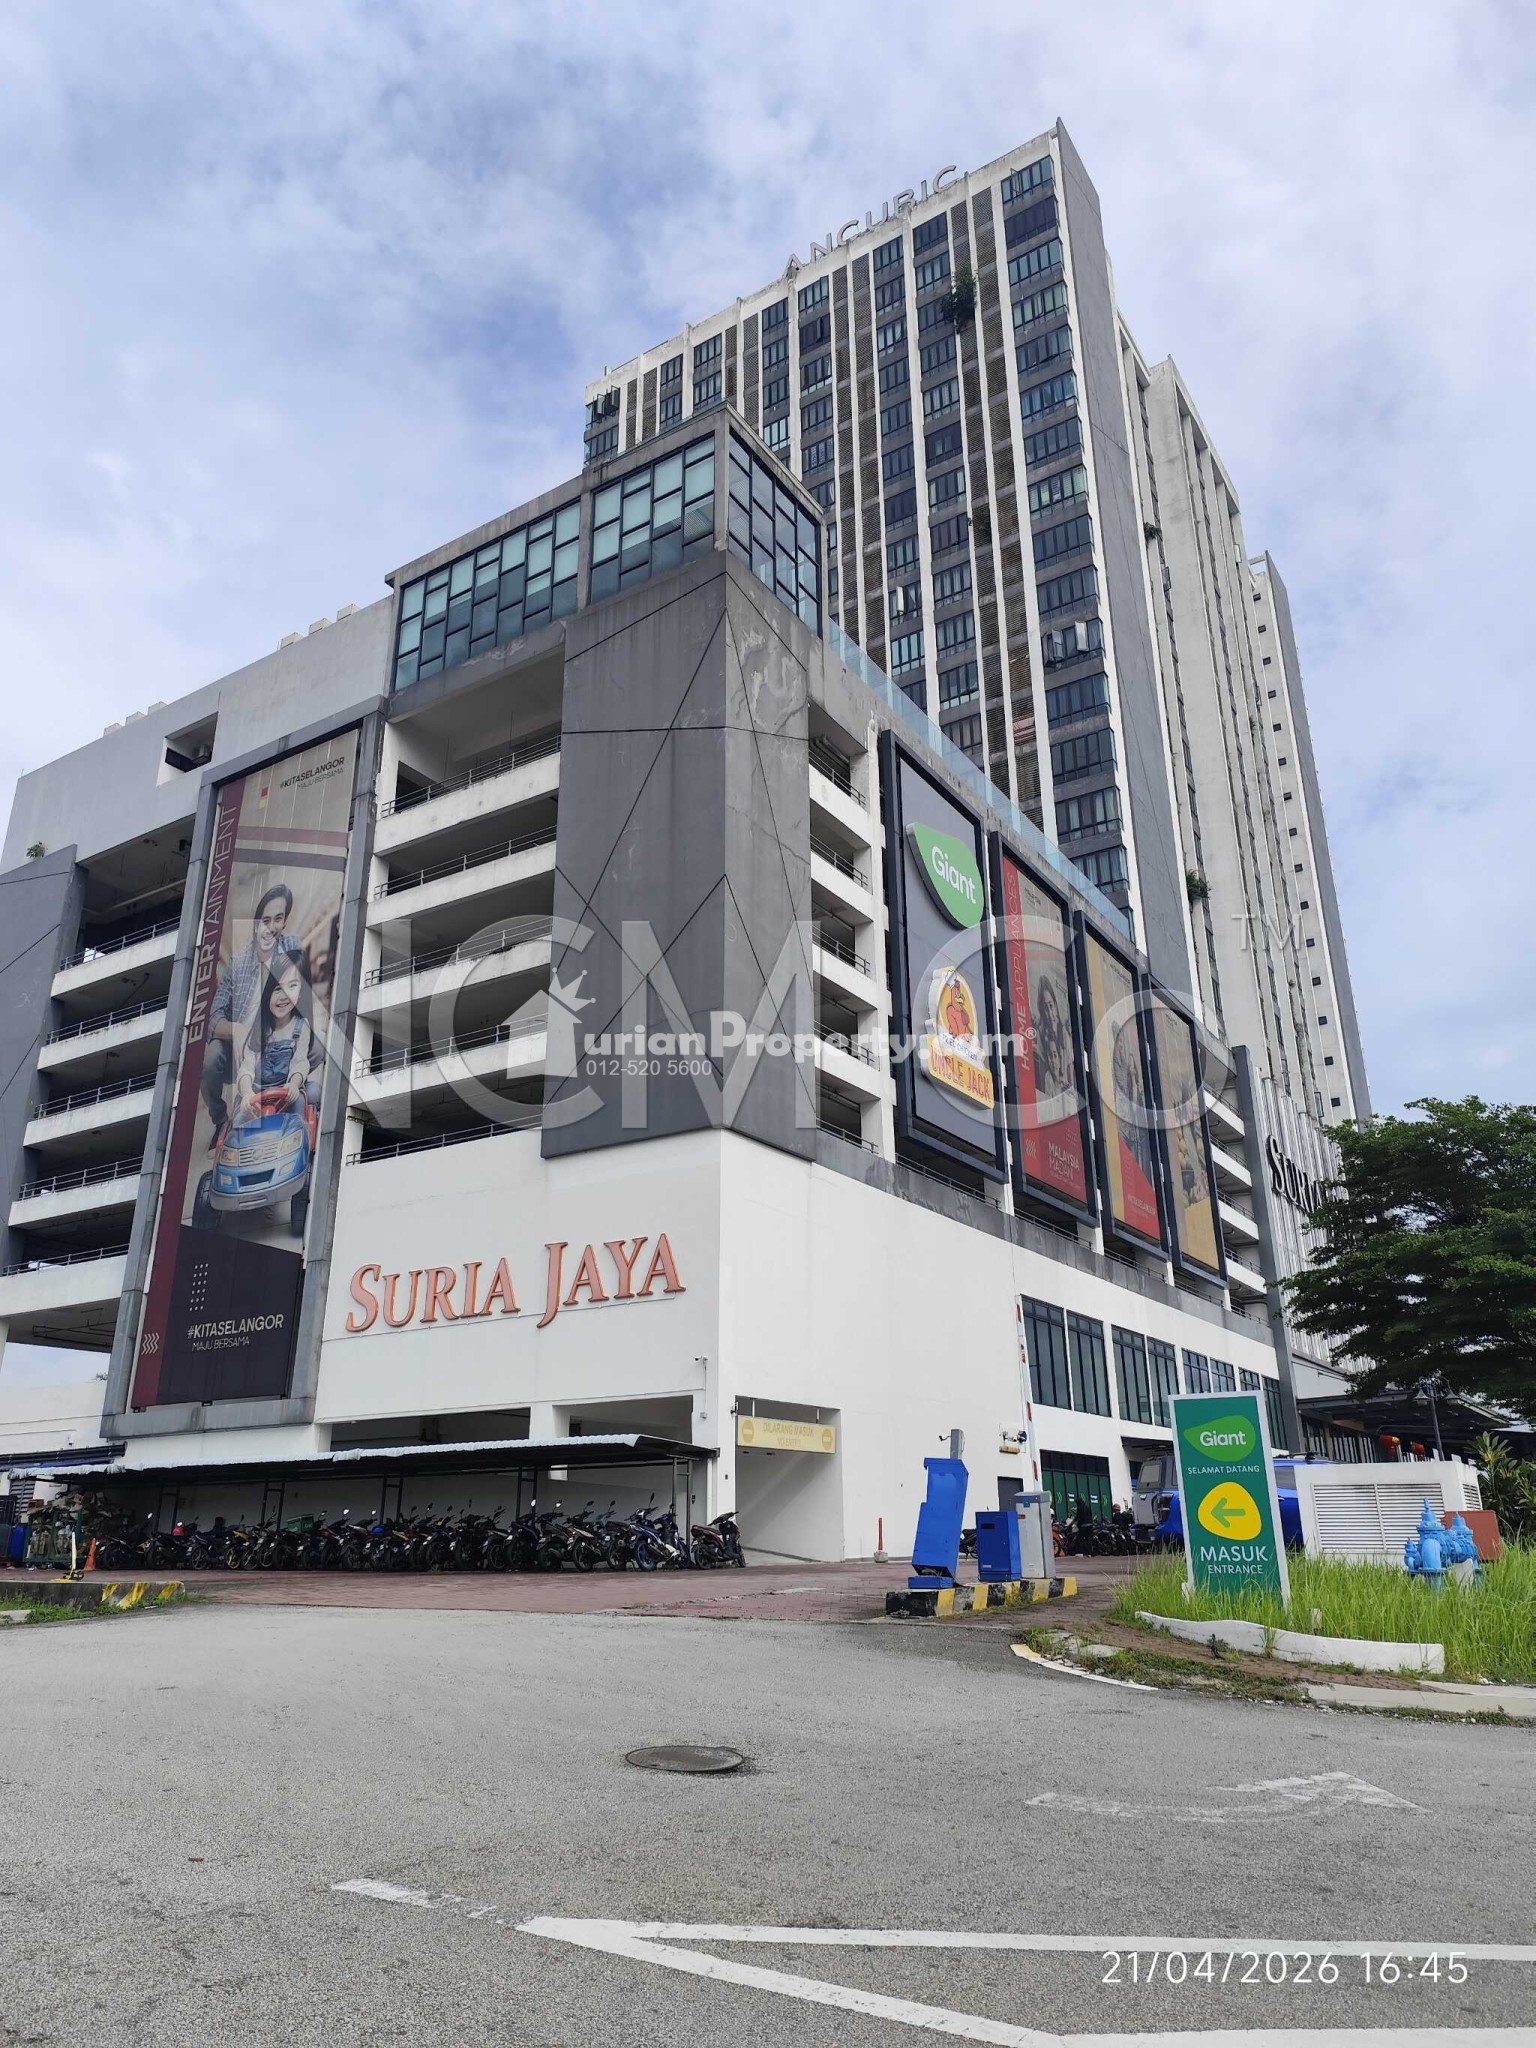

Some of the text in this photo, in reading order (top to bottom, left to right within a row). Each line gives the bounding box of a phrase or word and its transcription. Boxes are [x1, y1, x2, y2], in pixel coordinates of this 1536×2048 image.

[280, 757, 345, 789] #KITASELANGOR
[931, 846, 976, 904] Giant
[188, 805, 237, 1044] ENTERTAINMENT
[1007, 872, 1030, 1070] HOME APPLIANCES
[930, 1044, 992, 1103] UNCLE JACK
[1048, 1140, 1080, 1170] MALAYSIA
[345, 1232, 686, 1333] SURIA JAYA
[187, 1313, 284, 1339] #KITASELANGOR
[192, 1336, 250, 1351] MAJU BERSAMA
[1200, 1430, 1246, 1446] Giant
[1187, 1465, 1260, 1475] SELAMAT DATANG
[1200, 1546, 1269, 1562] MASUK
[1207, 1564, 1264, 1575] ENTRANCE
